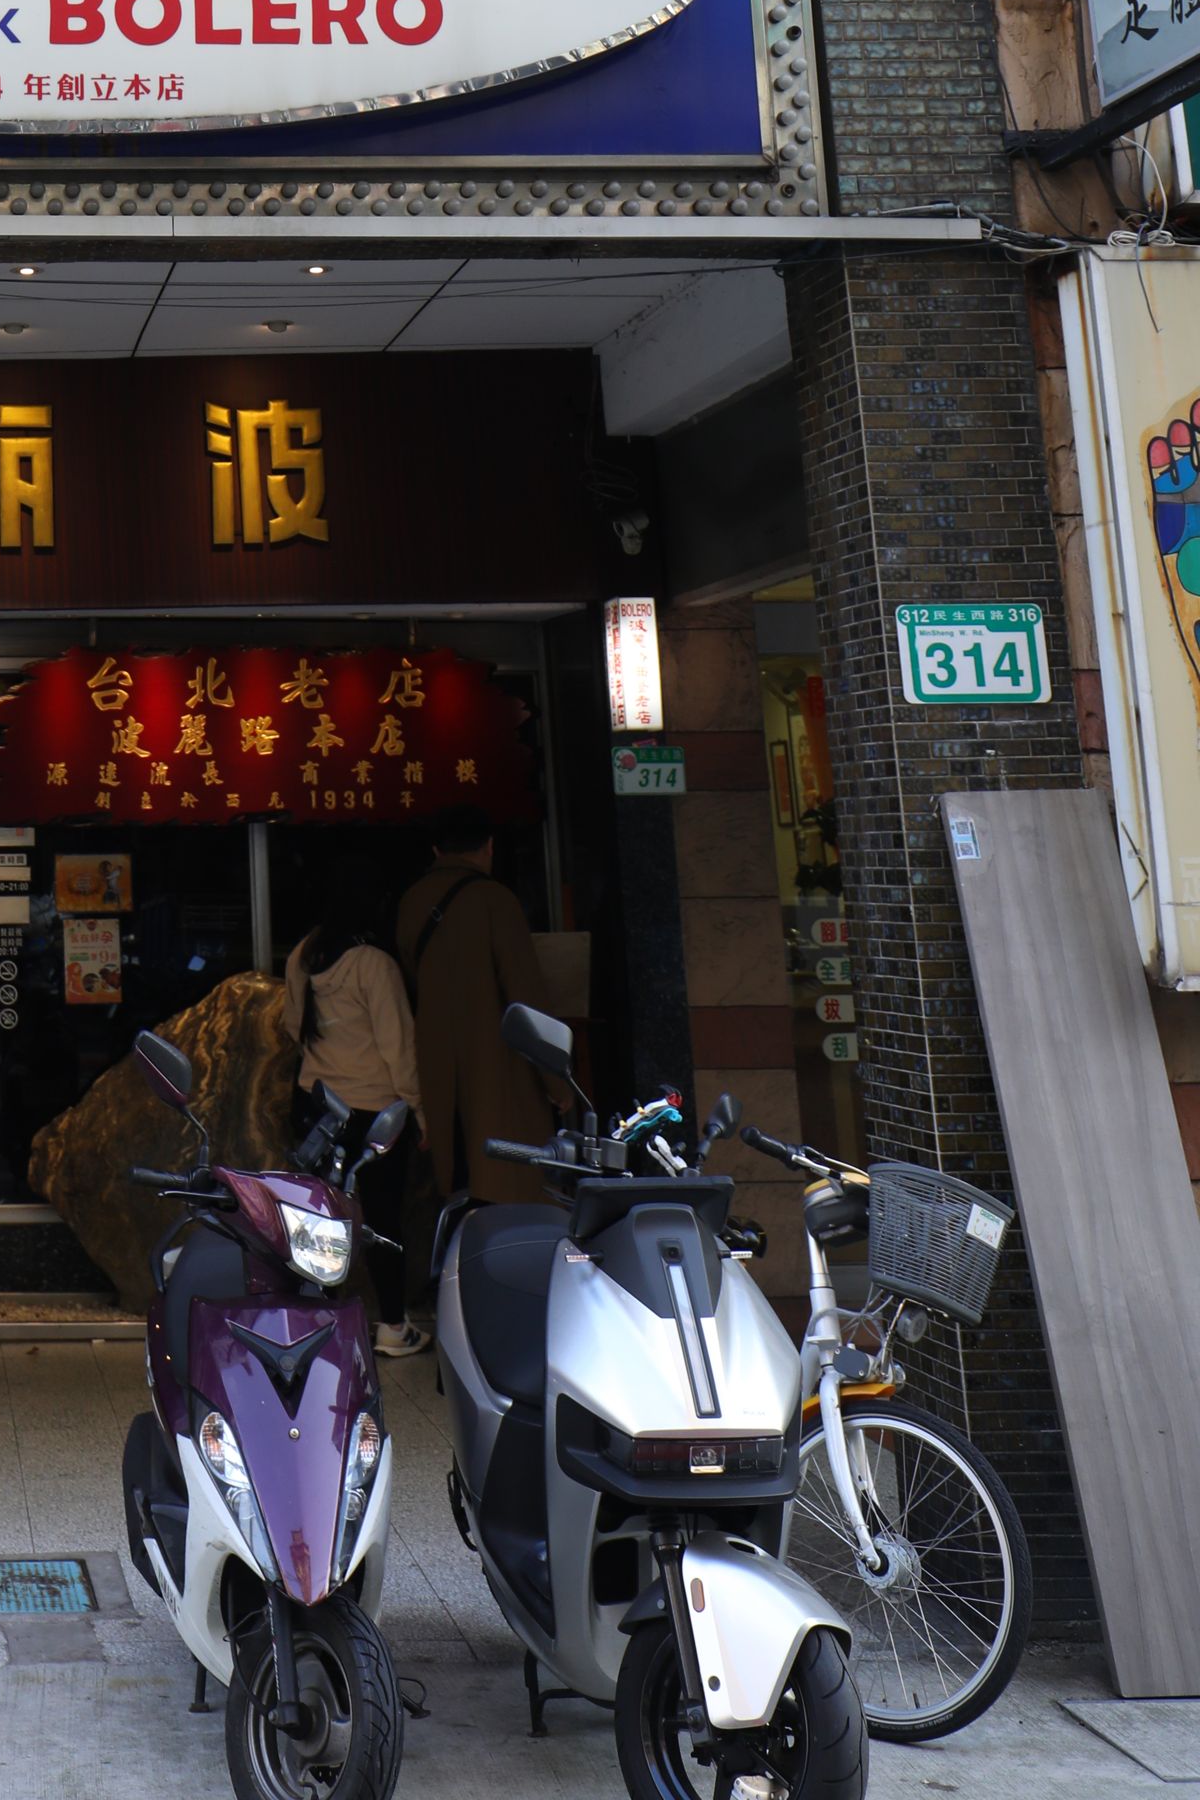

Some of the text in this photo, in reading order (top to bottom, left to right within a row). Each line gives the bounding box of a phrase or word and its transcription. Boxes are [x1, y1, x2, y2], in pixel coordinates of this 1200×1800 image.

[620, 602, 653, 618] BOLERO
[900, 608, 1038, 623] 312 民生西路 316
[925, 641, 1025, 689] 314
[86, 657, 426, 712] 台北老店
[111, 713, 407, 759] 波麗路本店
[638, 767, 678, 788] 314
